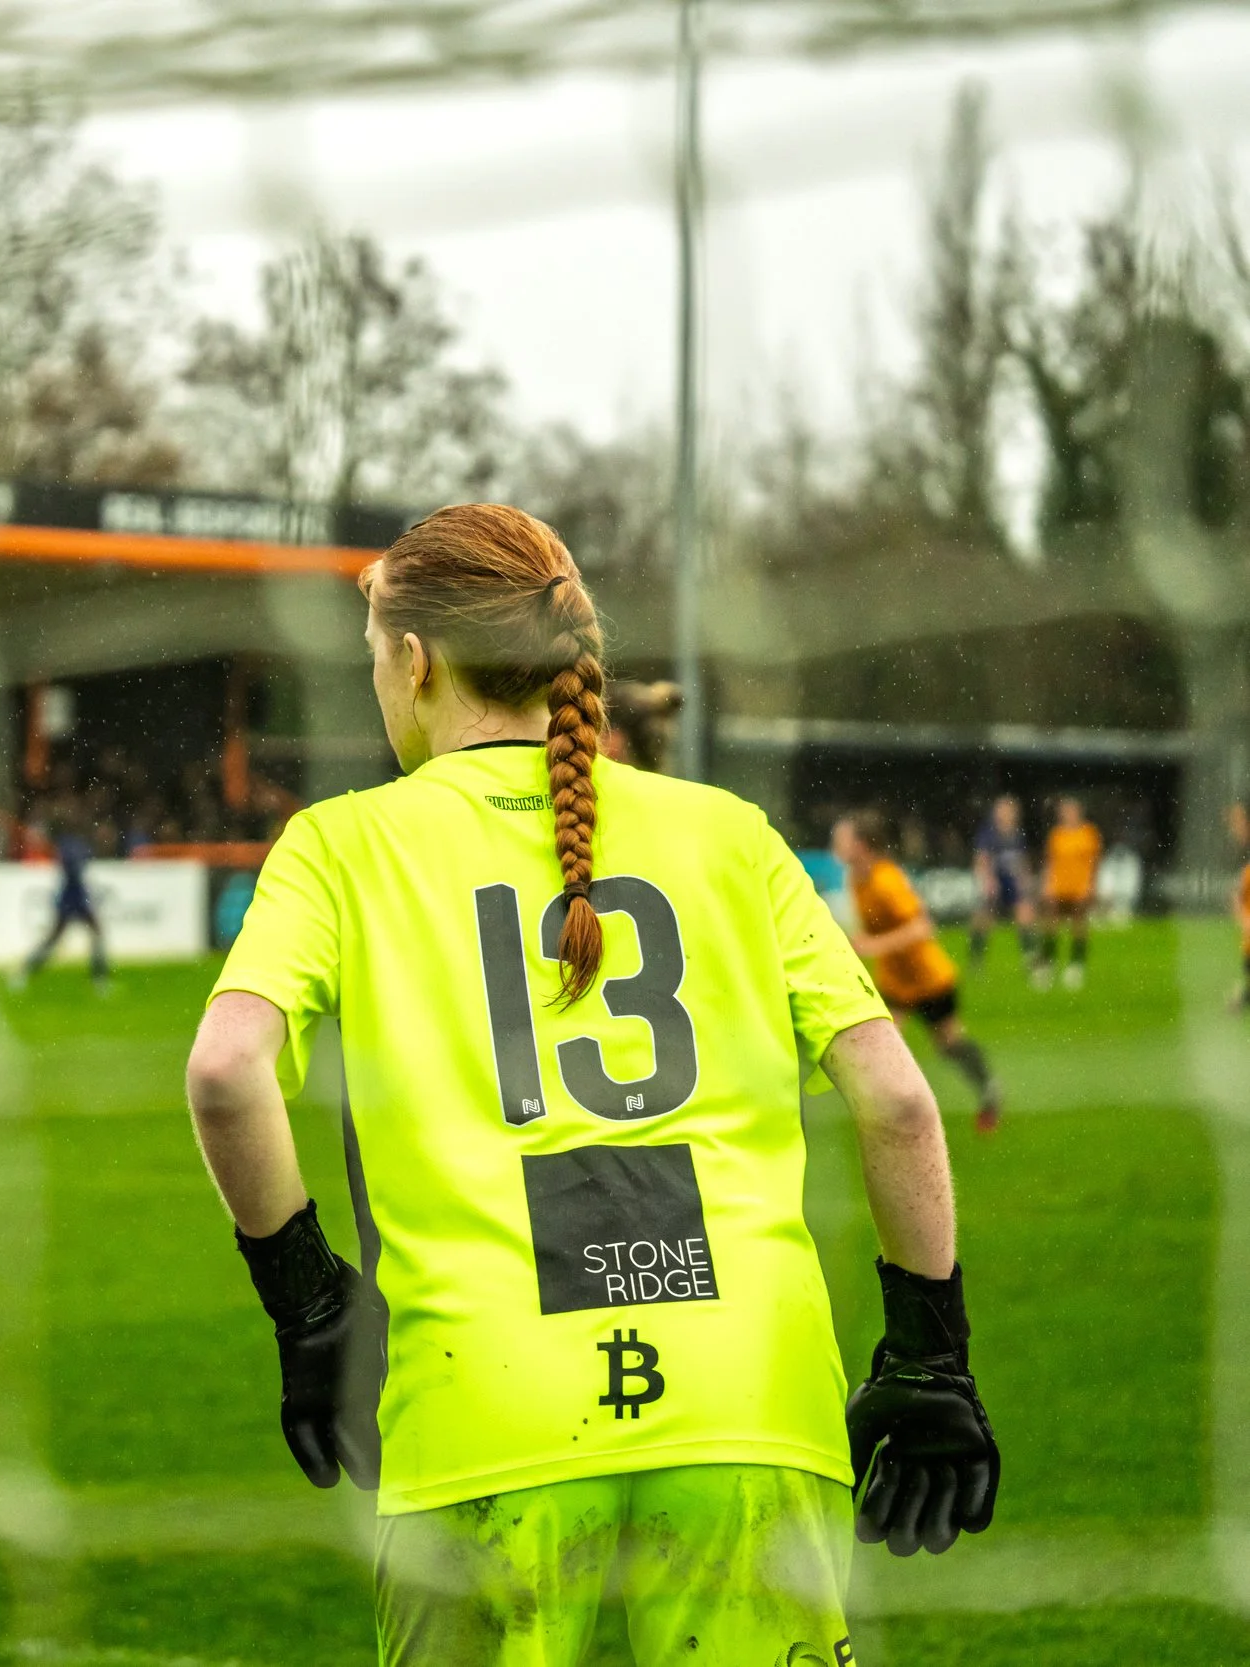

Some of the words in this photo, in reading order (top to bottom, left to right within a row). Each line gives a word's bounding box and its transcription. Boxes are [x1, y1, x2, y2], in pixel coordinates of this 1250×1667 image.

[473, 874, 699, 1127] 13
[583, 1237, 708, 1274] STONE
[605, 1267, 714, 1303] RIDGE
